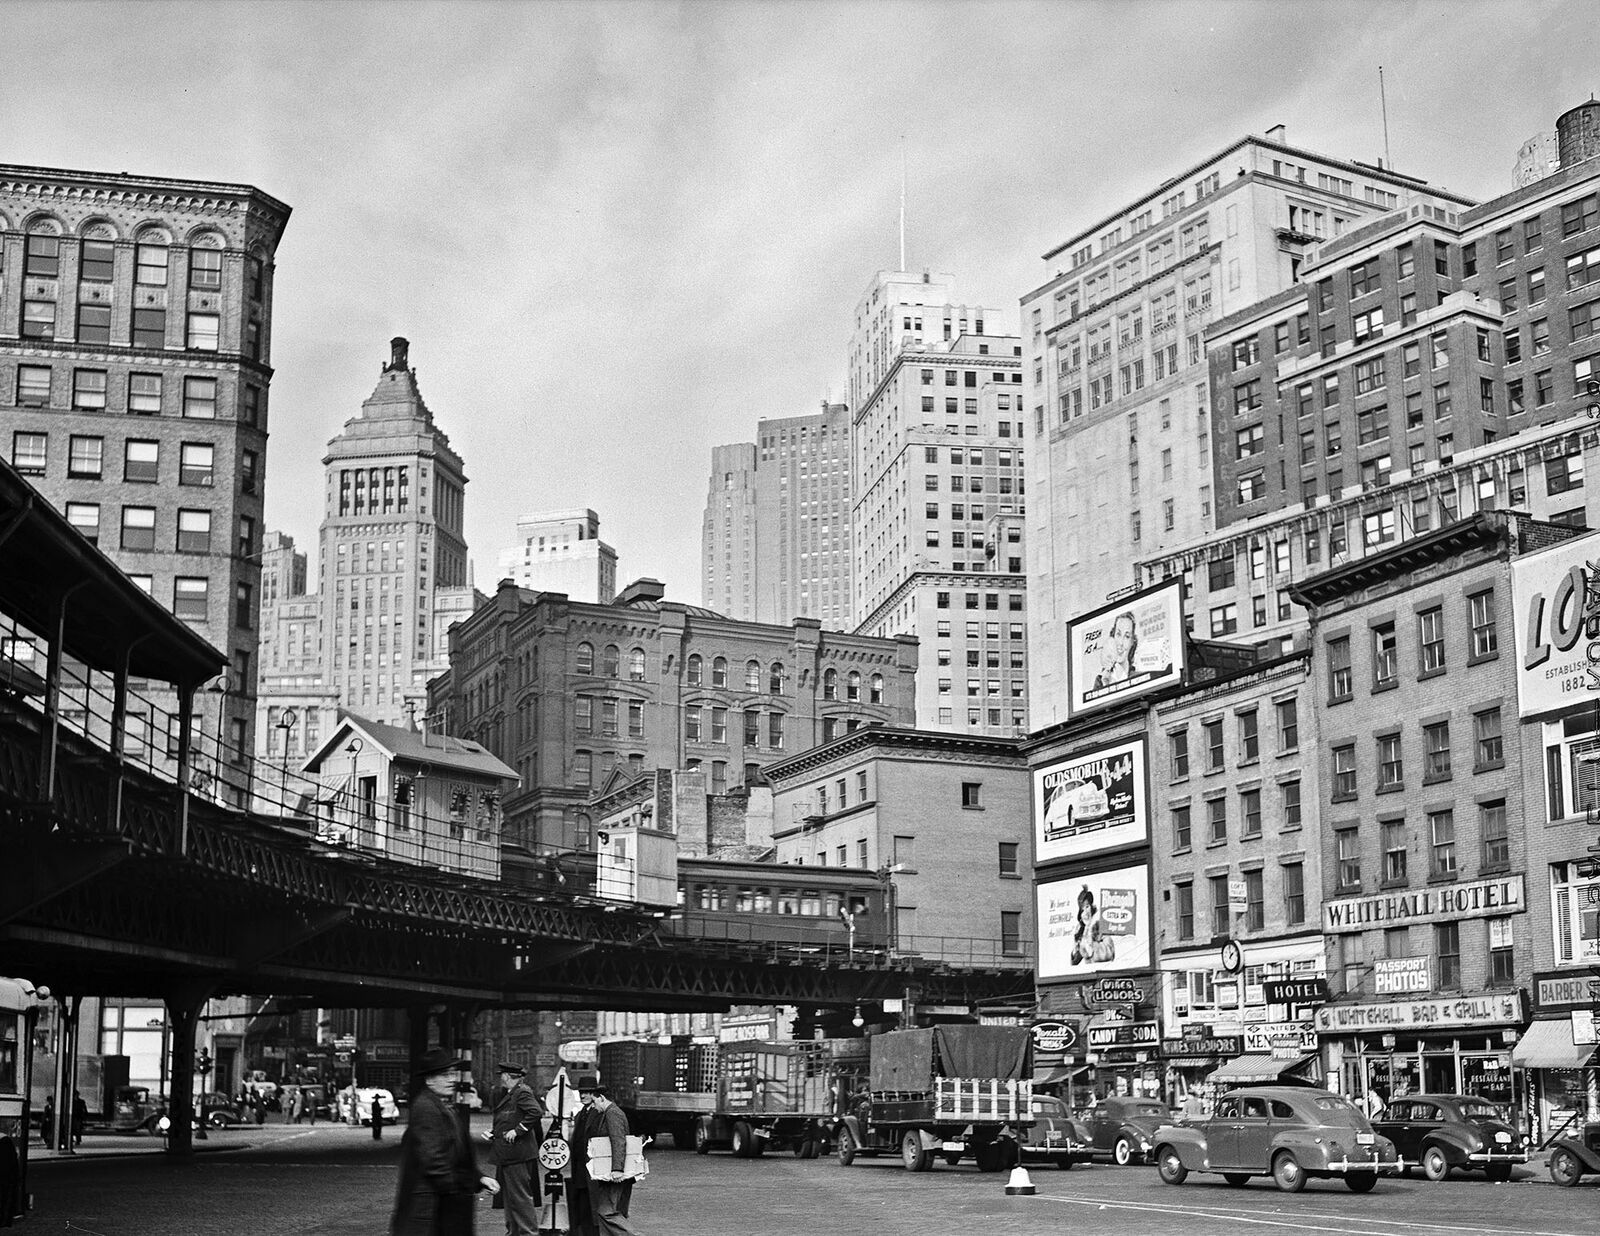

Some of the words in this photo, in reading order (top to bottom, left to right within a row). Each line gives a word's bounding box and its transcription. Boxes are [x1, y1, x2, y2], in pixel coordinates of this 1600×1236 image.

[1524, 557, 1600, 671] LO
[1084, 629, 1103, 643] FRESH
[1561, 675, 1586, 693] 1882
[1044, 759, 1108, 789] OLDSMOBILE
[1328, 893, 1434, 927] WHITEHALL
[1440, 883, 1518, 913] HOTEL
[1375, 959, 1428, 973] PASSPORT
[1103, 980, 1132, 990] WINES
[1375, 970, 1428, 991] PHOTOS
[1095, 990, 1141, 1001] LIQUORS
[1274, 984, 1322, 999] HOTEL
[1540, 979, 1583, 1001] BARBER
[1337, 1005, 1402, 1025] WHITEHALL
[1411, 1005, 1438, 1023] BAR
[1454, 1001, 1491, 1019] GRILL
[980, 1016, 1017, 1026] UNITED
[1264, 1024, 1296, 1032] UNITED
[1033, 1027, 1068, 1041] Rexall
[1089, 1028, 1117, 1043] CANDY
[1133, 1026, 1157, 1041] SODA
[1247, 1032, 1315, 1048] MENAR
[1273, 1048, 1300, 1059] PHOTOS
[1376, 1074, 1411, 1082] RESTURANT
[1528, 1082, 1536, 1116] STEAKS
[543, 1140, 567, 1151] BUS
[541, 1154, 567, 1165] STOP
